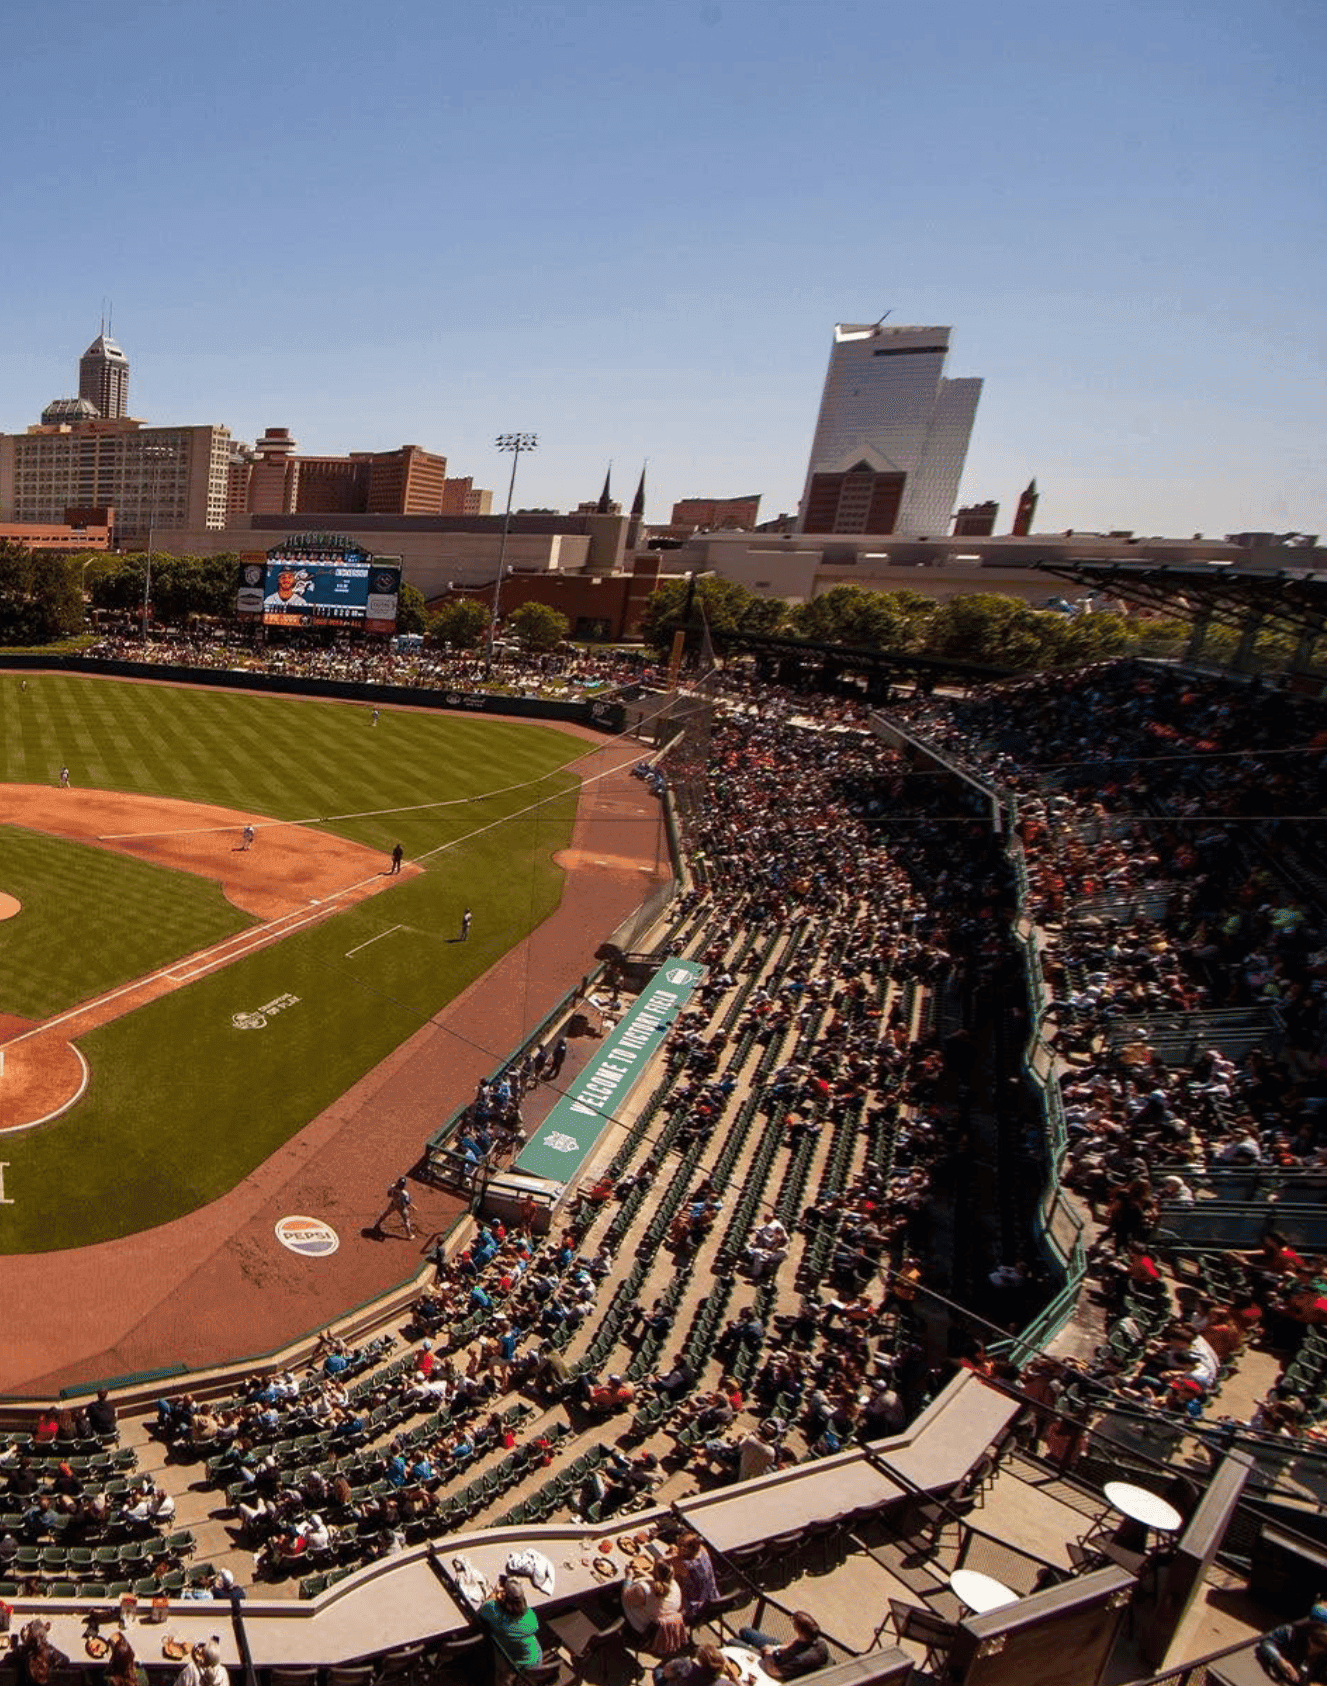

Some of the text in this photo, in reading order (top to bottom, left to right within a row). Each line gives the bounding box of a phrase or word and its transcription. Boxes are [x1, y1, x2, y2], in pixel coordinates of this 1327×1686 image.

[570, 989, 679, 1117] WELCOME TO VICTORY FIELD
[283, 1231, 332, 1240] PEPSI
